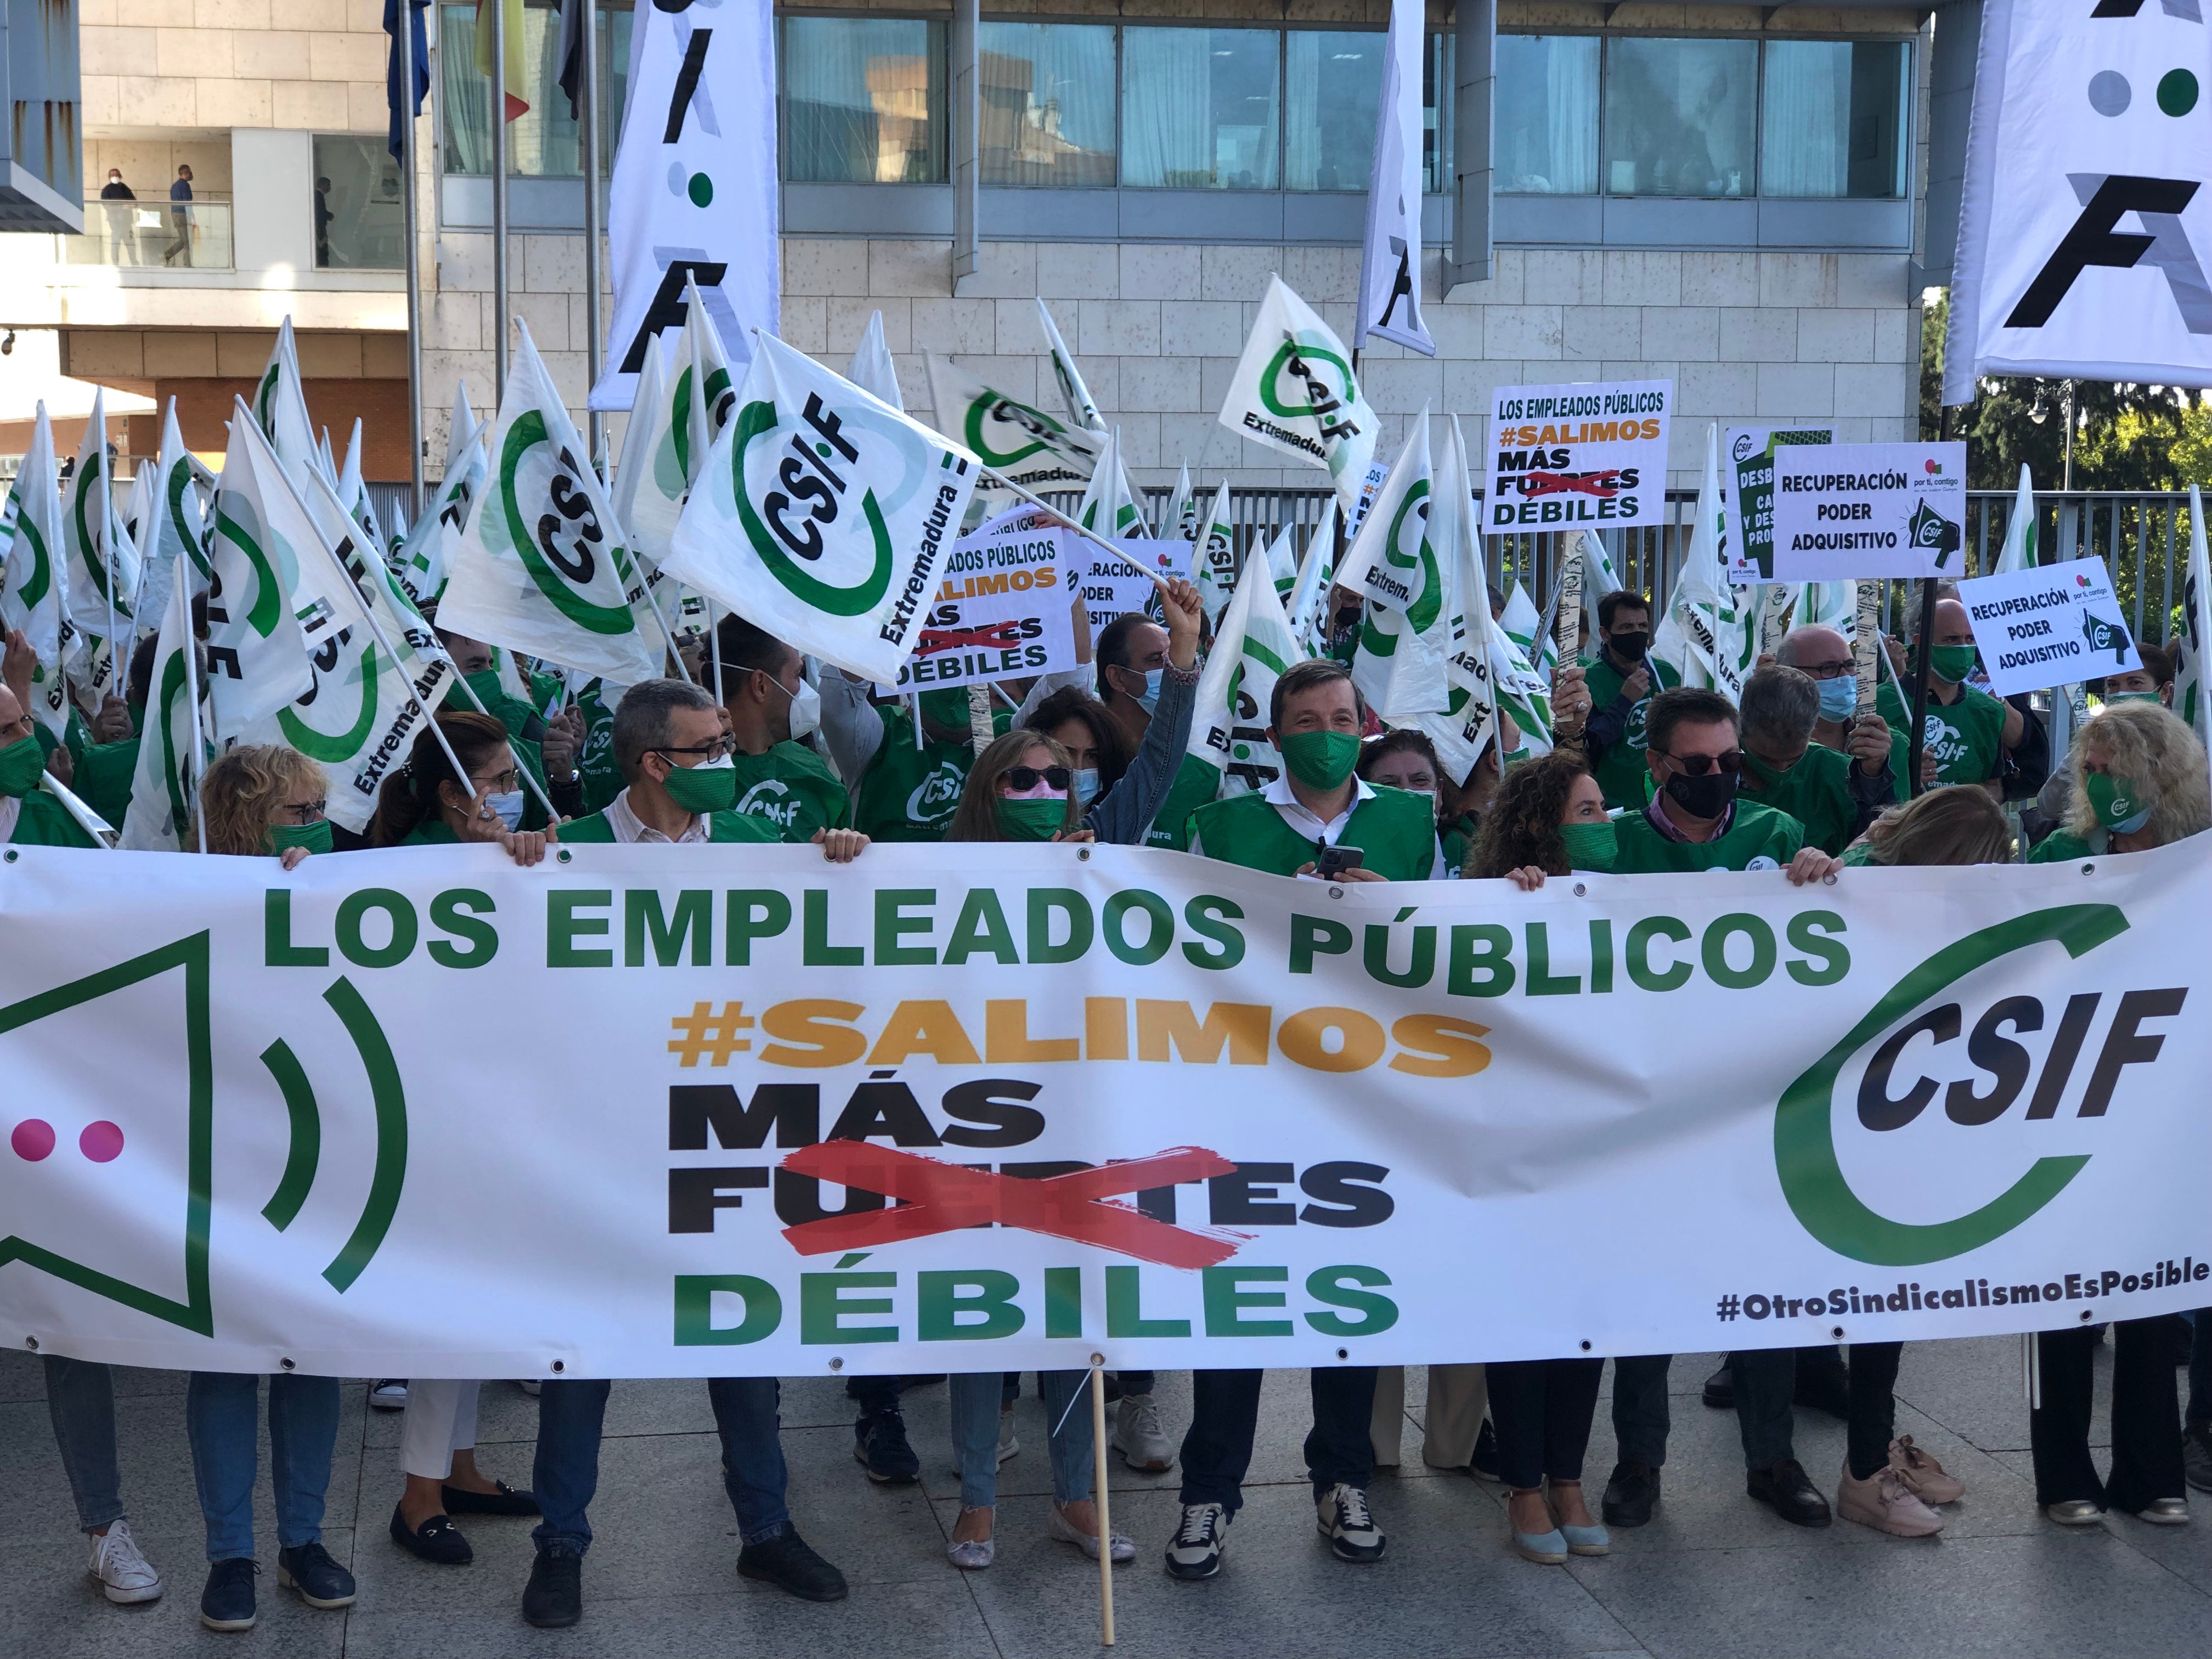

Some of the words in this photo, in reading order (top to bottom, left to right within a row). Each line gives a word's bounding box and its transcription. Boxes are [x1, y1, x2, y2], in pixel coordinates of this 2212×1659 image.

[1499, 399, 1523, 420] LOS
[1526, 395, 1600, 419] EMPLEADOS
[1604, 389, 1664, 415] PÚBLICOS
[1499, 419, 1661, 447] #SALIMOS
[1497, 446, 1571, 471] MÁS
[1782, 469, 1908, 492] RECUPERACIÓN
[1934, 477, 1958, 486] contigo
[1493, 496, 1639, 525] DÉBILES
[1818, 503, 1872, 521] PODER
[944, 550, 983, 574] ADOS
[987, 540, 1056, 567] PÚBLICOS
[1791, 532, 1898, 551] ADQUISITIVO
[879, 484, 958, 647] Extremadura
[1365, 565, 1408, 602] Extrem
[1971, 588, 2070, 620] RECUPERACIÓN
[2007, 619, 2053, 641] PODER
[1999, 640, 2080, 669] ADQUISITIVO
[265, 888, 499, 968] LOS
[547, 888, 1246, 970] EMPLEADOS
[1289, 906, 1851, 998] PÚBLICOS
[668, 998, 1492, 1078] #SALIMOS
[1857, 988, 2189, 1132] CSIF
[669, 1070, 1046, 1150] MÁS
[674, 1253, 1399, 1347] DÉBILES
[1717, 1256, 2210, 1322] #OtroSindicalismoEsPosible
